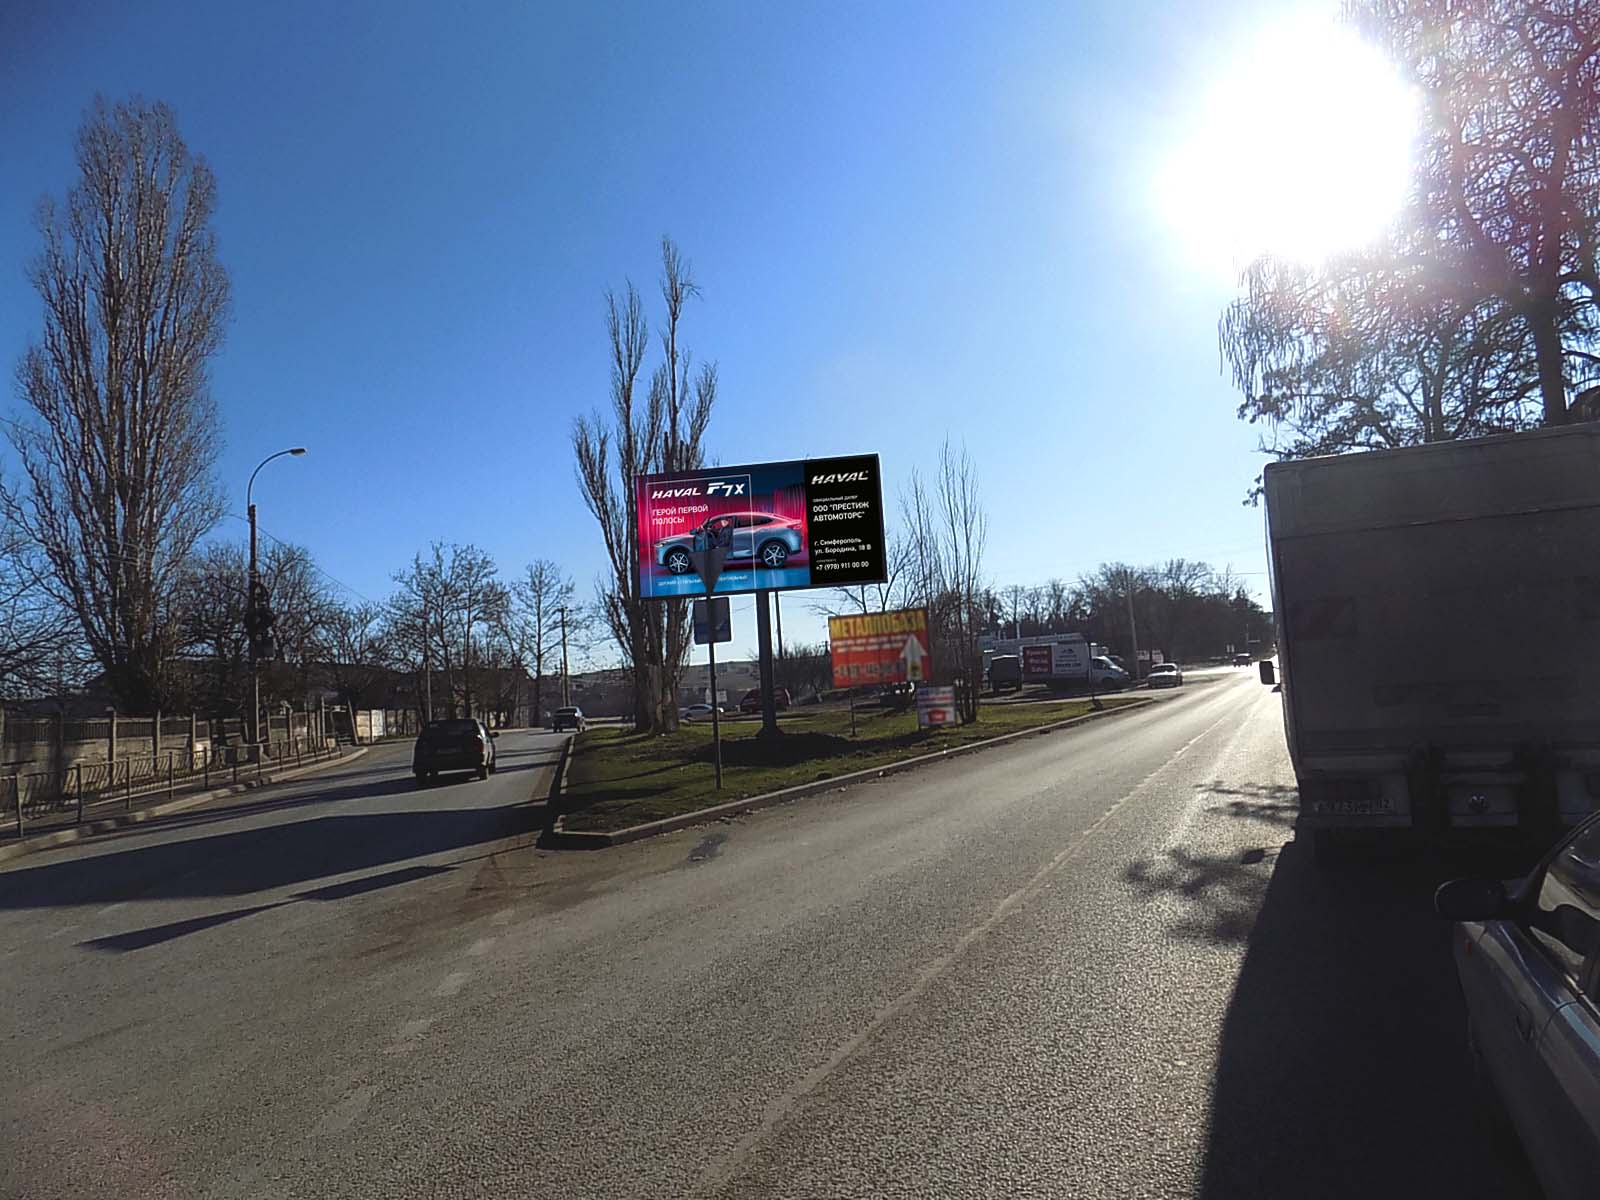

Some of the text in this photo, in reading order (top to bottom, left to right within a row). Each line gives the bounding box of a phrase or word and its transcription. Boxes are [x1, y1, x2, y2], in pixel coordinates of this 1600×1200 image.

[811, 471, 868, 484] HAVAL
[652, 482, 745, 499] HAVAL F7X
[652, 504, 709, 516] ГЕРОЙ ПЕРВОЙ
[652, 516, 685, 525] ПОЛОСЫ
[824, 563, 840, 571] (978)
[852, 561, 860, 569] 00
[861, 560, 869, 568] 00
